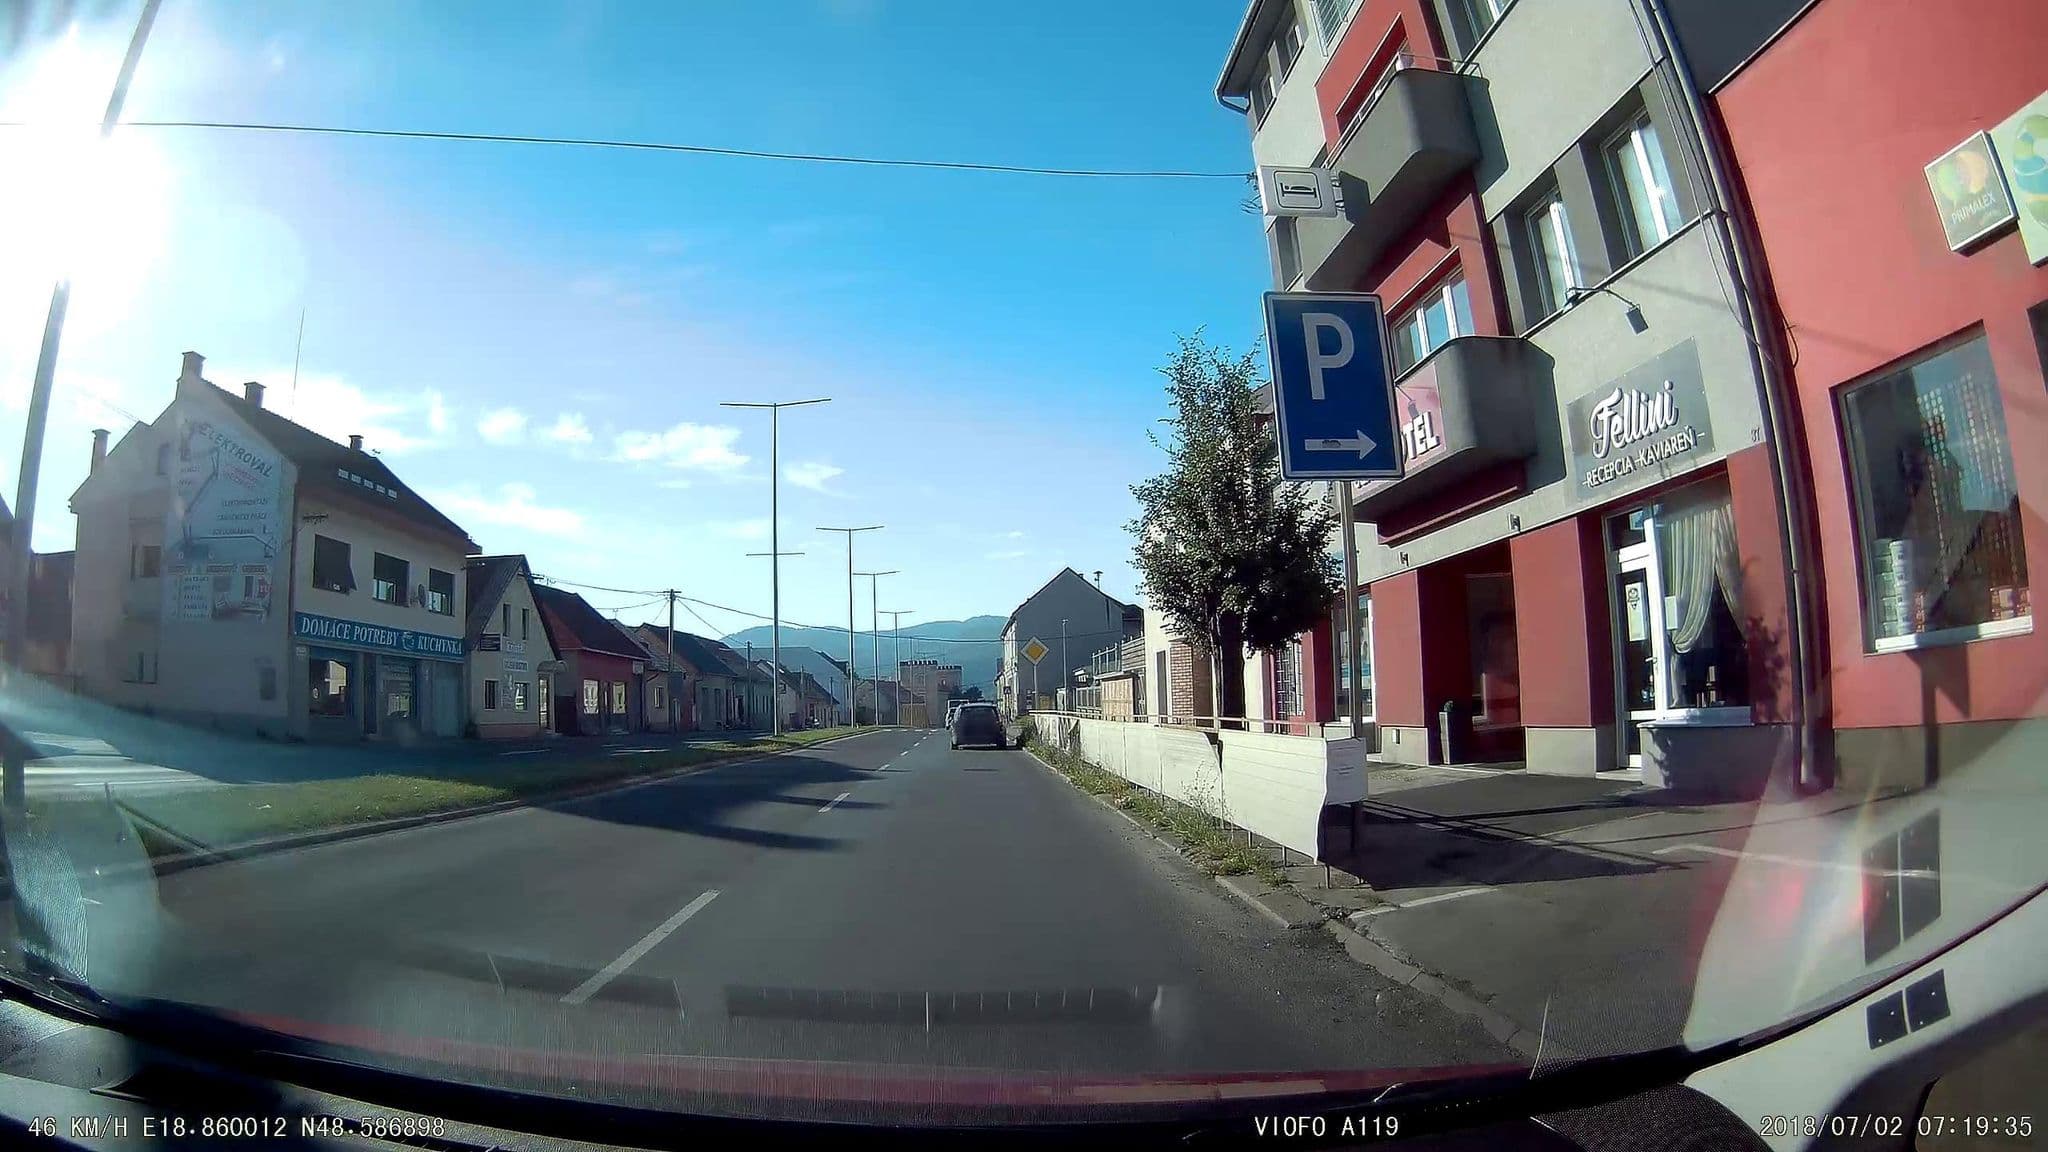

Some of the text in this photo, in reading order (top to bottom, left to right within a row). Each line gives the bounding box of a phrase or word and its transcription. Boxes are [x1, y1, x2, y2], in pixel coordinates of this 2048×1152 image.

[1951, 190, 1996, 225] PRIMALEX
[1301, 312, 1355, 400] P
[1590, 380, 1680, 459] Fellini
[301, 617, 351, 640] DOMÁCE
[353, 625, 401, 648] POTREBY
[417, 635, 463, 655] KUCHYNKA
